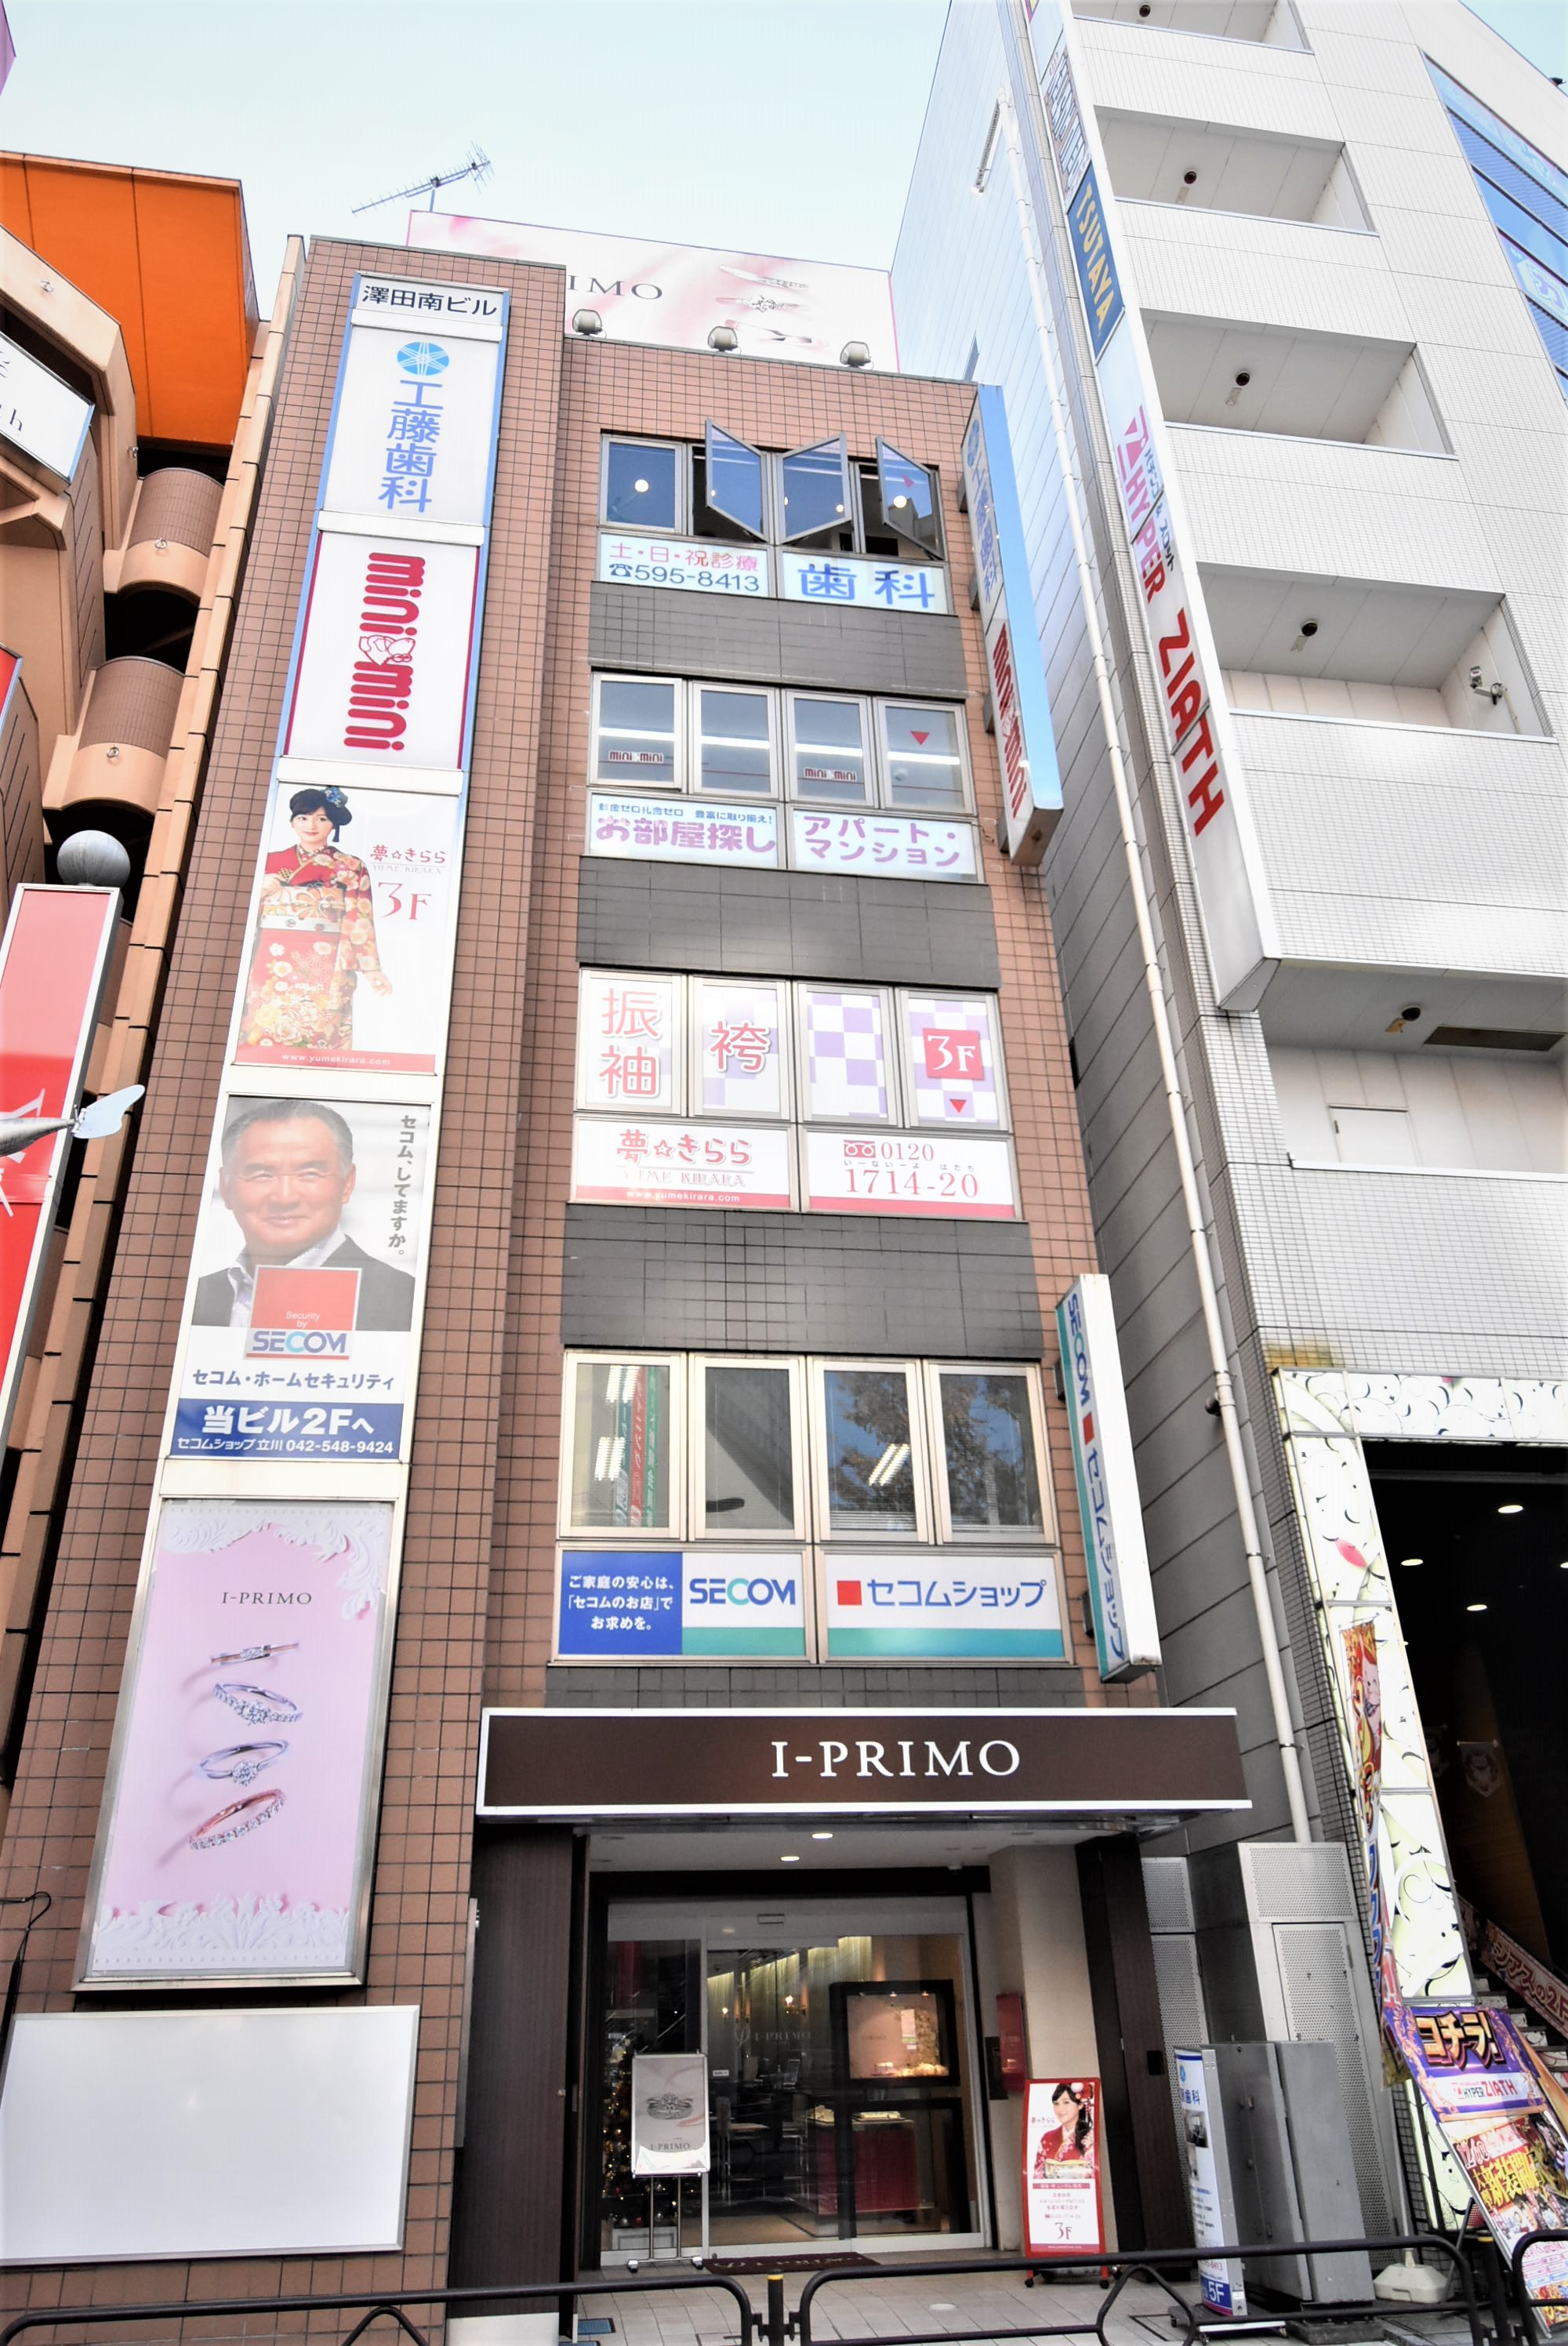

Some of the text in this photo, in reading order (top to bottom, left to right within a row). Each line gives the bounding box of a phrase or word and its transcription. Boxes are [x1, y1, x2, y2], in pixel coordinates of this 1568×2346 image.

[1076, 182, 1113, 330] TSUTAYA
[361, 285, 498, 318] 澤田南ビル
[378, 380, 444, 514] 工藤歯科
[609, 542, 760, 572] 土・日・祝診療
[634, 563, 760, 593] 595-8413
[798, 562, 935, 608] 歯科
[343, 551, 426, 751] mini mini
[1126, 464, 1225, 837] HYPER ZIATH
[609, 750, 663, 764] mini mini
[804, 768, 857, 782] mini mini
[596, 815, 776, 853] お部屋探し
[804, 837, 960, 866] マンション
[378, 881, 432, 921] 3F
[598, 986, 662, 1098] 振袖
[708, 1020, 771, 1073] 袴
[927, 1034, 977, 1072] 3F
[281, 1051, 391, 1067] www.yumekirara.com
[880, 1141, 935, 1162] 0120
[388, 1114, 418, 1256] セコム、してますか。
[626, 1189, 740, 1203] www.yumekirara.com
[844, 1168, 979, 1198] 1714-20
[285, 1309, 321, 1323] Security
[296, 1319, 308, 1330] by
[252, 1331, 348, 1354] SECOM
[1067, 1292, 1091, 1407] SECOM
[192, 1369, 396, 1392] セコム・ホームセキュリティ
[202, 1404, 375, 1436] 当ビル2Fへ
[285, 1439, 394, 1454] 042-548-9424
[1087, 1446, 1126, 1661] セコムショップ
[568, 1574, 675, 1590] ご家庭の安心は、
[689, 1578, 797, 1606] SECOM
[867, 1578, 1048, 1608] セコムショップ
[221, 1591, 313, 1606] I-PRIMO
[568, 1594, 673, 1611] 「セコムのお店」で
[590, 1616, 652, 1632] お求めを。
[771, 1739, 1020, 1778] I-PRIMO
[1462, 2078, 1519, 2098] HYPER ZIATH
[1054, 2221, 1073, 2240] 3F
